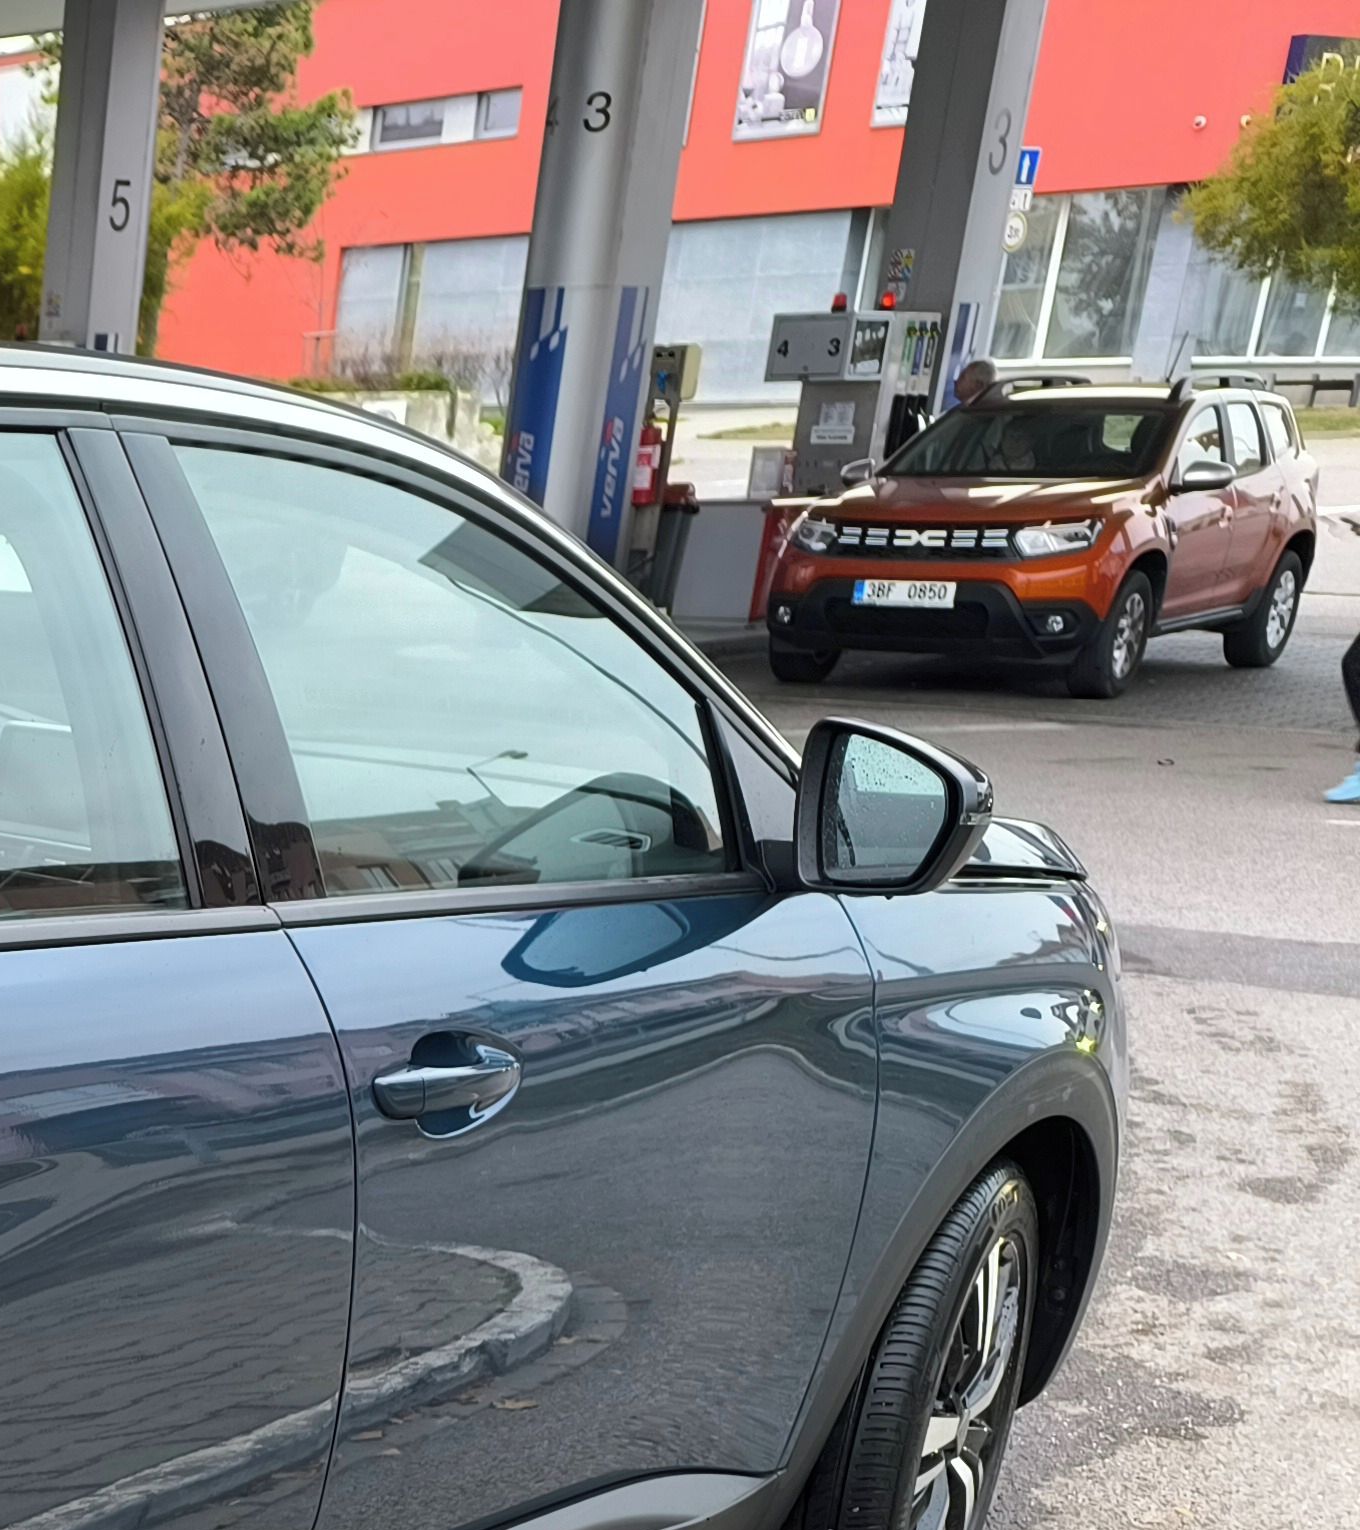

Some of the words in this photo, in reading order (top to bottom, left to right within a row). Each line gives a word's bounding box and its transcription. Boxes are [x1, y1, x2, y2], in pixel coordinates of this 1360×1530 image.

[583, 91, 612, 133] 3
[988, 107, 1012, 176] 3
[109, 179, 131, 232] 5
[776, 339, 789, 358] 4
[827, 338, 841, 357] 3
[507, 430, 535, 493] erva
[600, 416, 625, 518] verva
[907, 583, 947, 601] 0850
